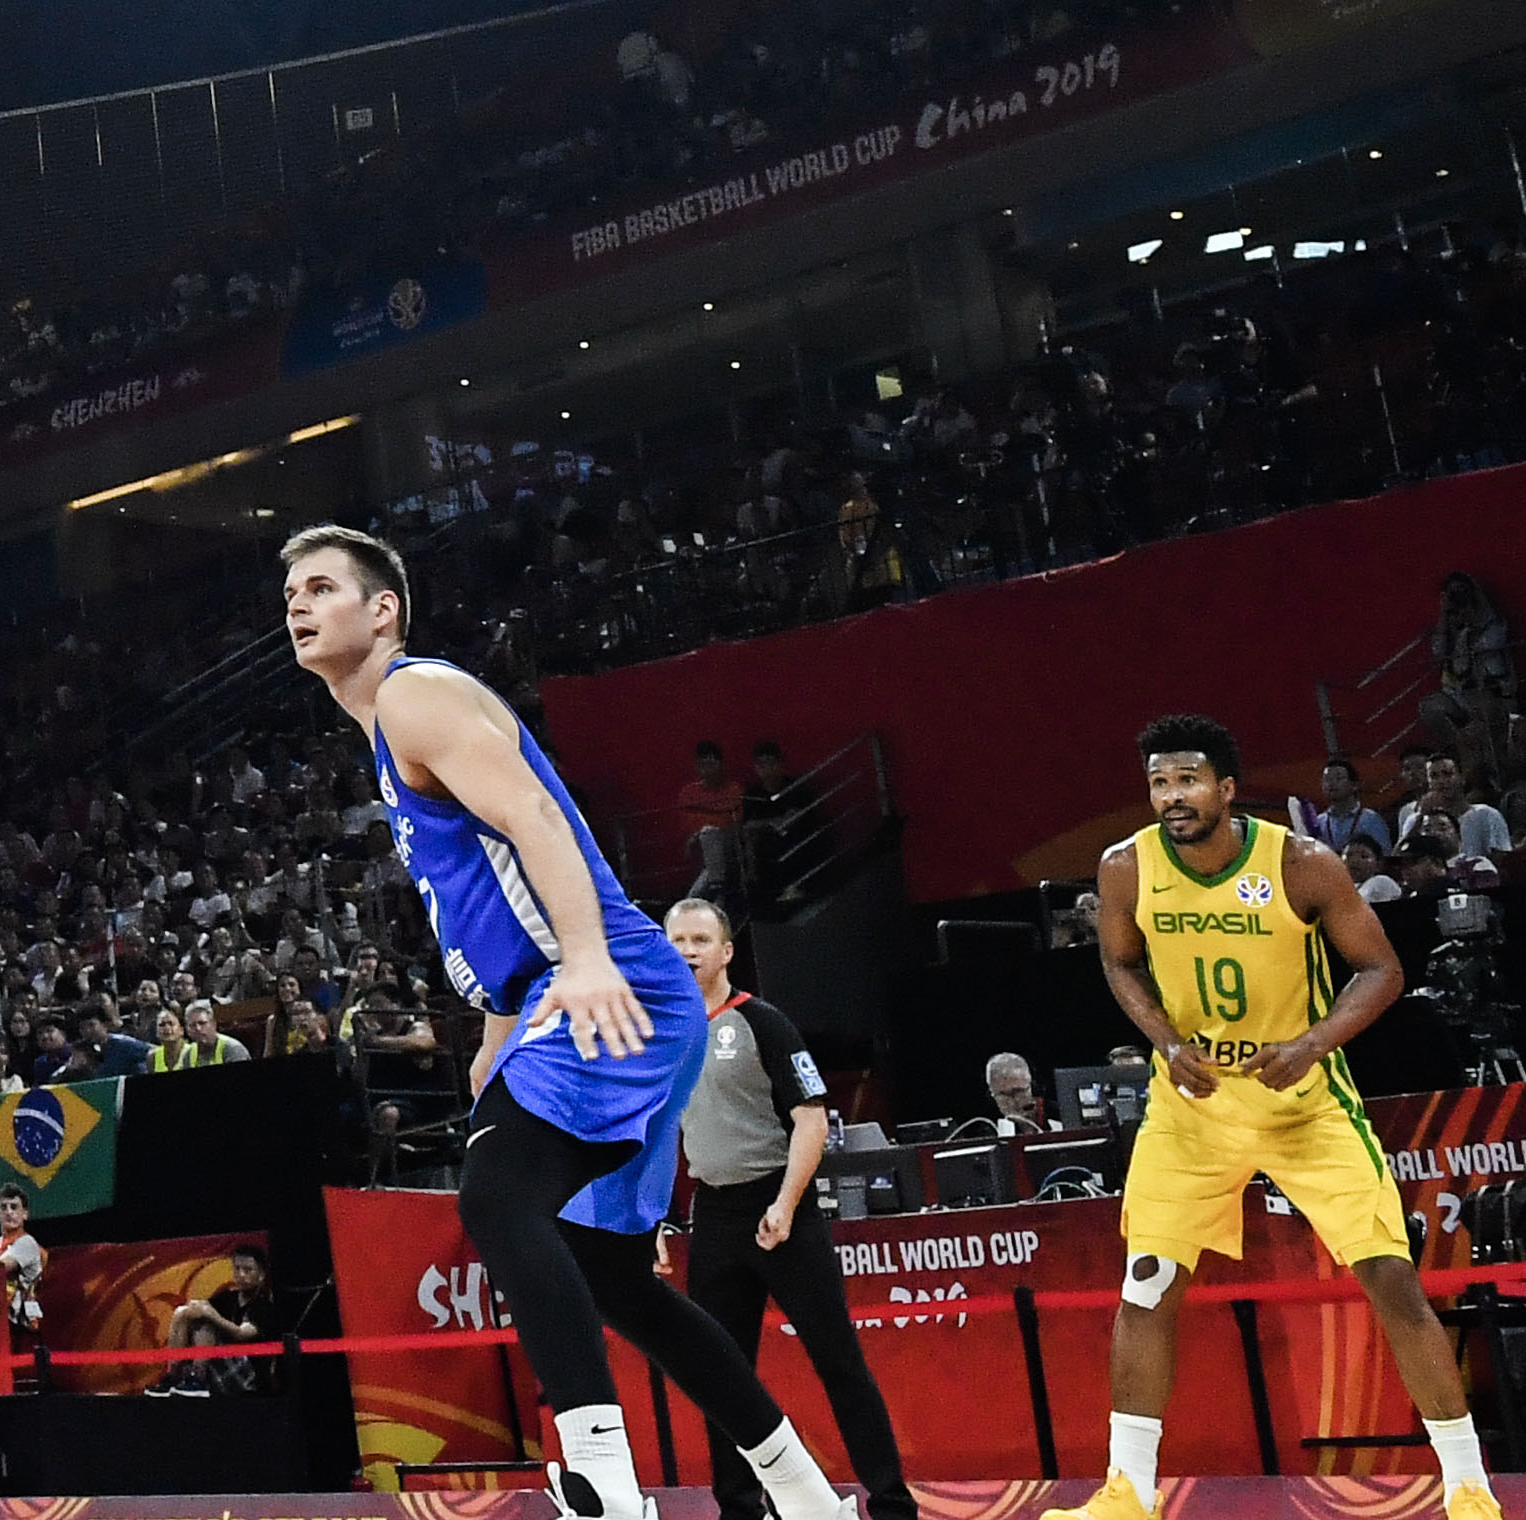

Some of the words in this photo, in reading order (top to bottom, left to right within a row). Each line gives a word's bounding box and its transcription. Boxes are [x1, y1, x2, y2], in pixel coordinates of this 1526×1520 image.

[571, 227, 621, 262] FIBA
[625, 176, 766, 245] BASKETBALL
[767, 144, 849, 192] WORLD
[854, 124, 901, 166] CUP
[913, 89, 1028, 150] China
[1035, 43, 1121, 108] 2019
[51, 374, 161, 431] SHENZHEN
[1153, 912, 1273, 936] BRASIL
[1194, 957, 1247, 1023] 19
[899, 1235, 985, 1272] WORLD
[990, 1231, 1039, 1265] CUP
